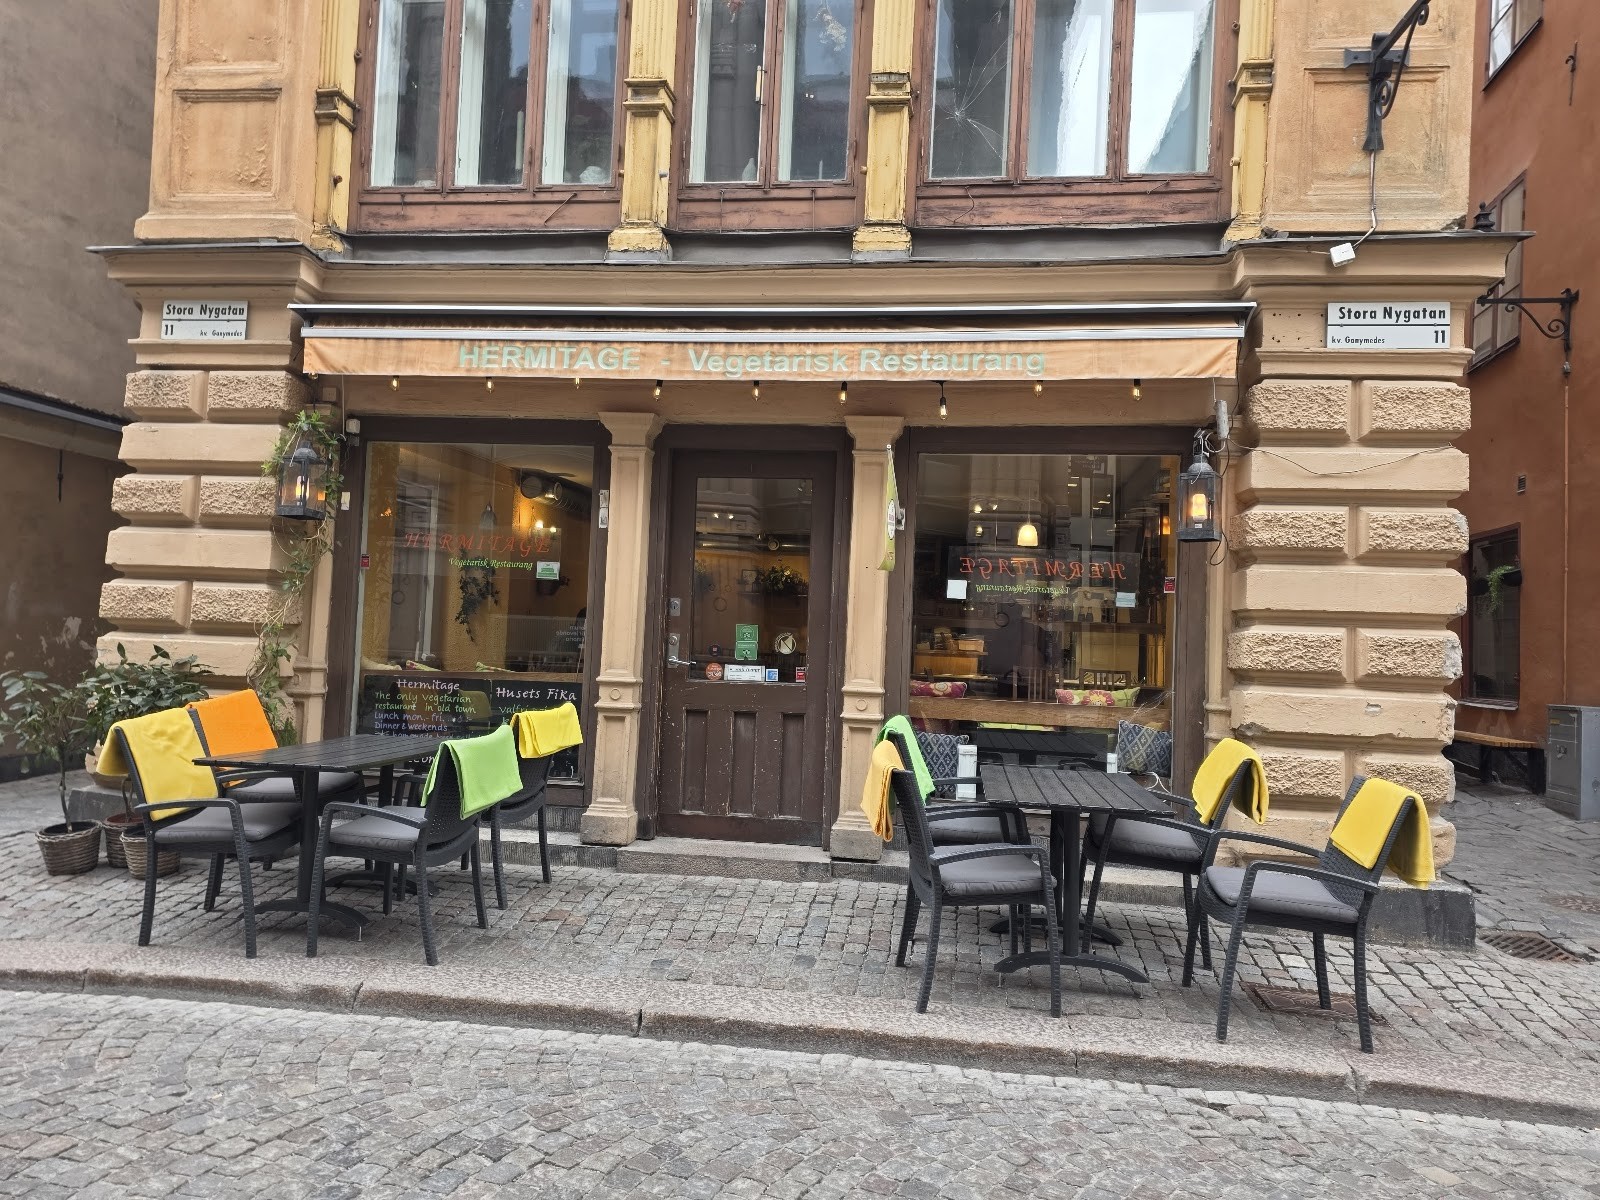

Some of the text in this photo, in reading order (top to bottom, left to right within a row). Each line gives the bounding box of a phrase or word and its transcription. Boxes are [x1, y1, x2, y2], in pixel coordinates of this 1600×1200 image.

[166, 304, 245, 319] Stora Nygatan
[1339, 306, 1446, 323] Stora Nygatan
[165, 324, 174, 336] 11
[1434, 330, 1446, 344] 11
[1331, 336, 1385, 345] kv. Ganymedes
[459, 344, 641, 370] HERMITAGE
[688, 347, 849, 378] Vegetarisk
[860, 347, 1045, 377] Restaurang
[403, 532, 550, 557] HERMITAGE
[449, 557, 533, 571] Vegetarisk Restaurang
[396, 679, 460, 694] Hermitage
[496, 687, 541, 699] Husets
[375, 691, 472, 706] The only vegetarian
[375, 702, 417, 711] restaurant
[425, 702, 434, 712] in
[438, 704, 451, 712] old
[374, 711, 400, 720] Lunch
[374, 720, 401, 729] Dinner
[407, 722, 448, 731] weekends
